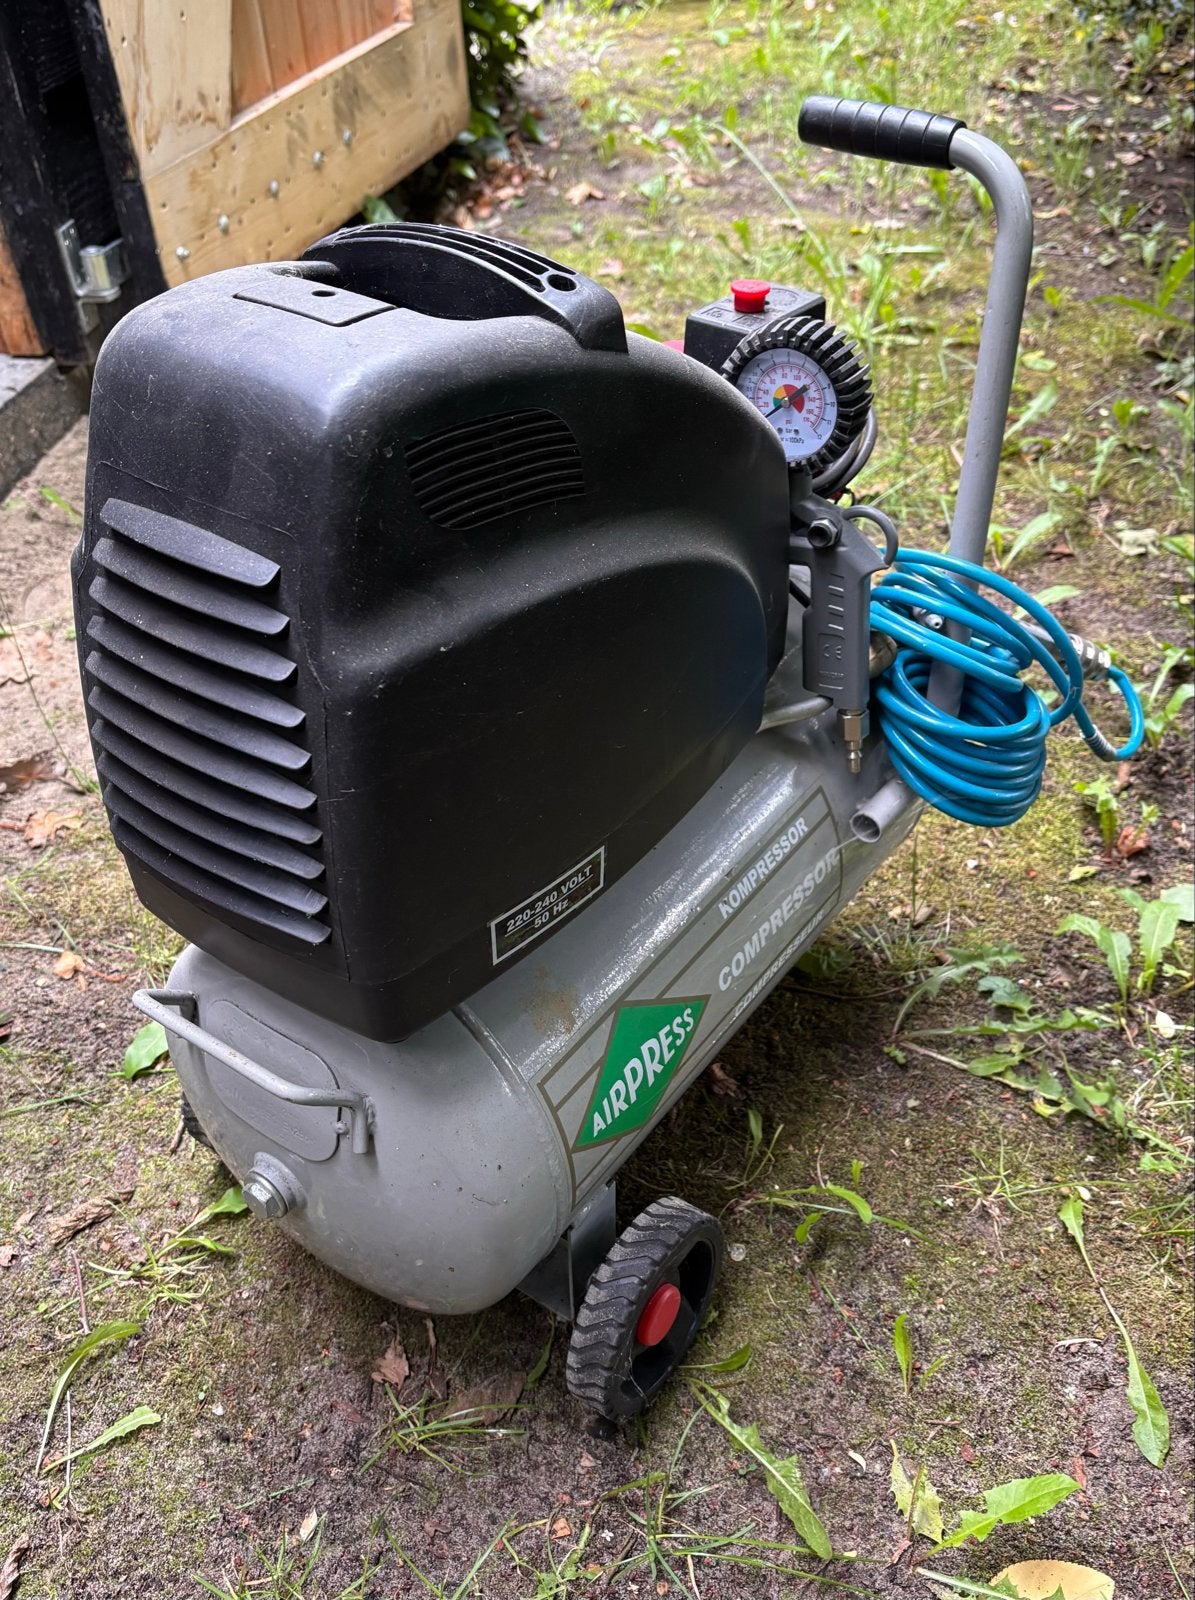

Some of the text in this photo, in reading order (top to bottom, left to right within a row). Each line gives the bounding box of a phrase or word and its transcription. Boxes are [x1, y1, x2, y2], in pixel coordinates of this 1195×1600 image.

[506, 864, 593, 933] 220-240 VOLT
[534, 899, 569, 929] 50 Hz
[717, 816, 809, 920] KOMPRESSOR
[717, 847, 841, 992] COMPRESSOR
[592, 1007, 695, 1138] AIRPRESS
